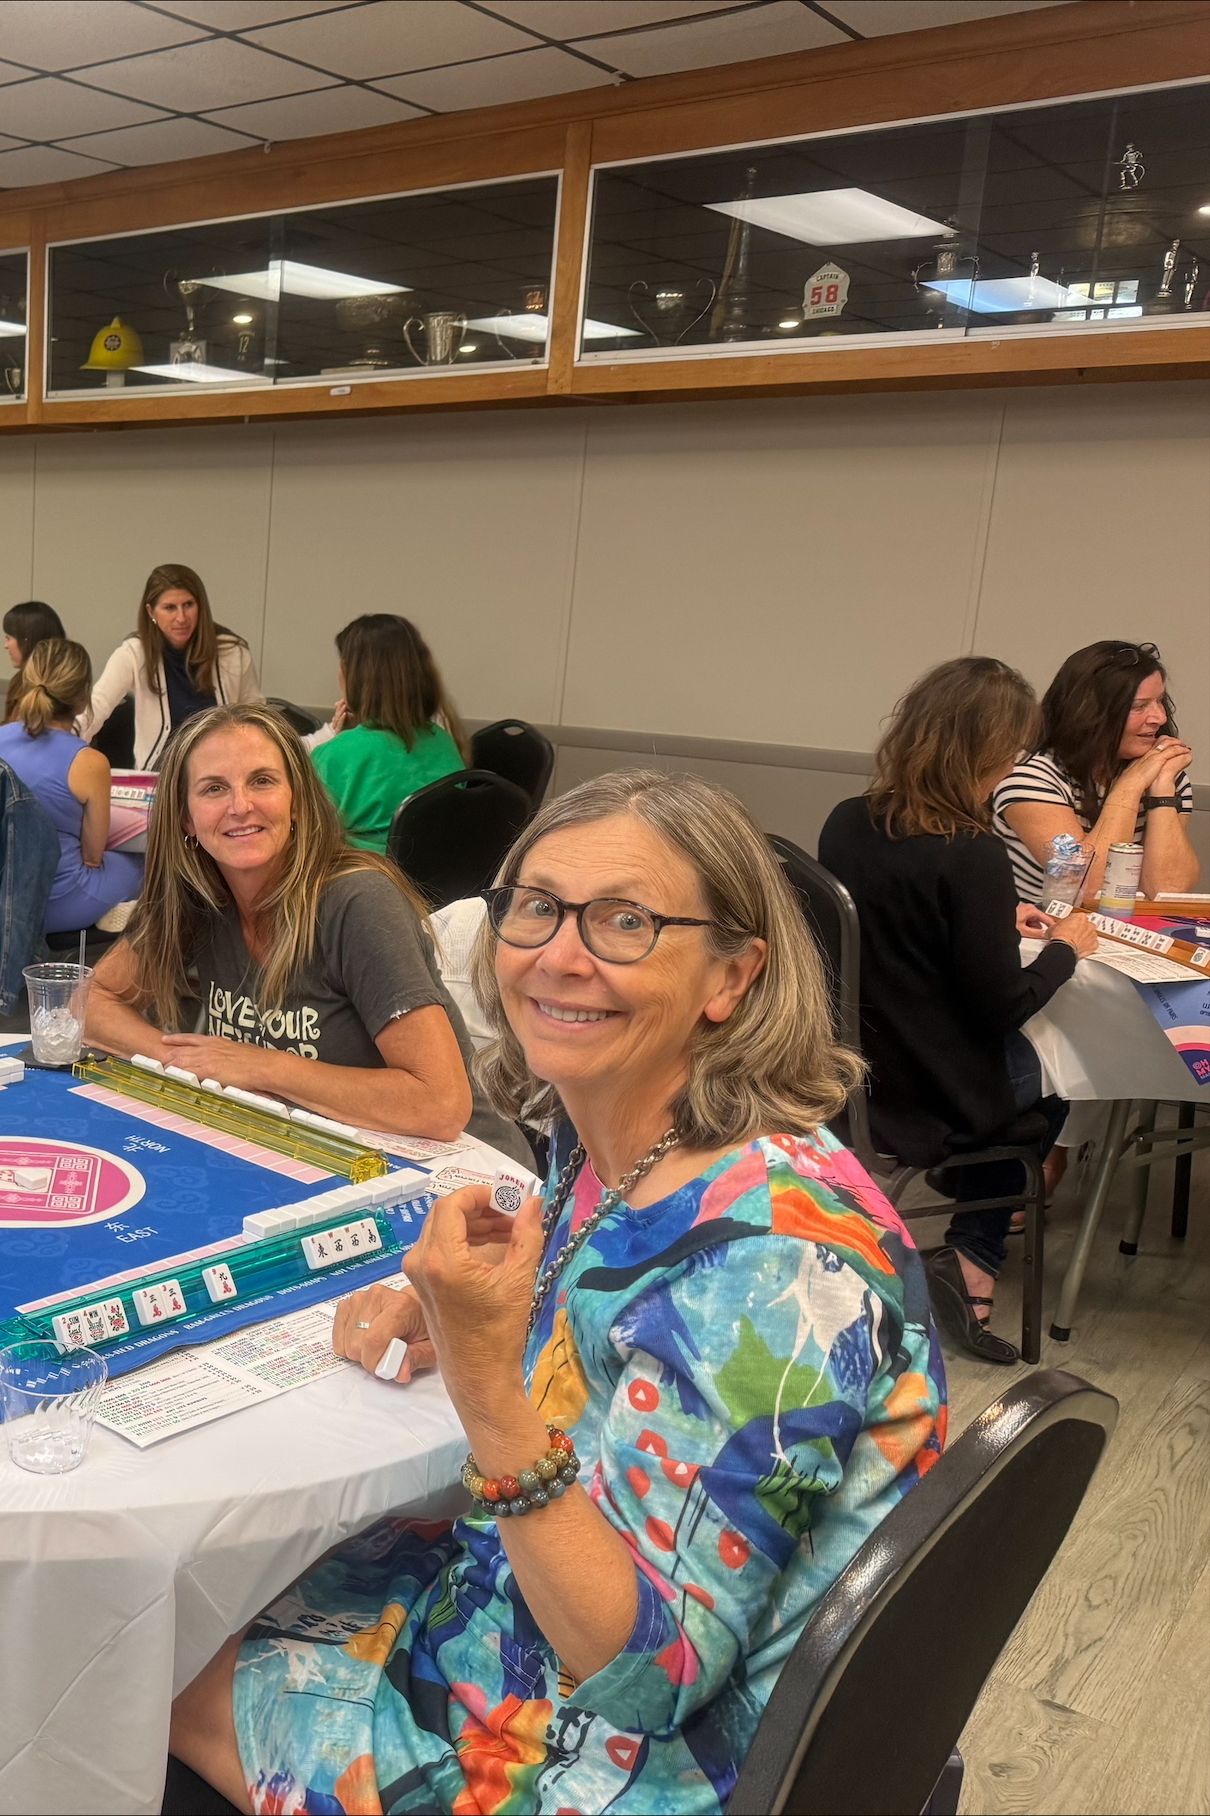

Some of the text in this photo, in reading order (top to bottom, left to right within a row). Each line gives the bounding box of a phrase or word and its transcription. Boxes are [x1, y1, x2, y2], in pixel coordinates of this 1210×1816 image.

[816, 273, 839, 281] CAPTAIN
[810, 284, 839, 306] 58
[208, 980, 321, 1041] LOVE YOUR
[122, 1142, 145, 1153] 北
[124, 1134, 171, 1154] NORTH
[499, 1174, 526, 1190] JOKER
[104, 1221, 130, 1233] 东
[115, 1226, 159, 1244] EAST
